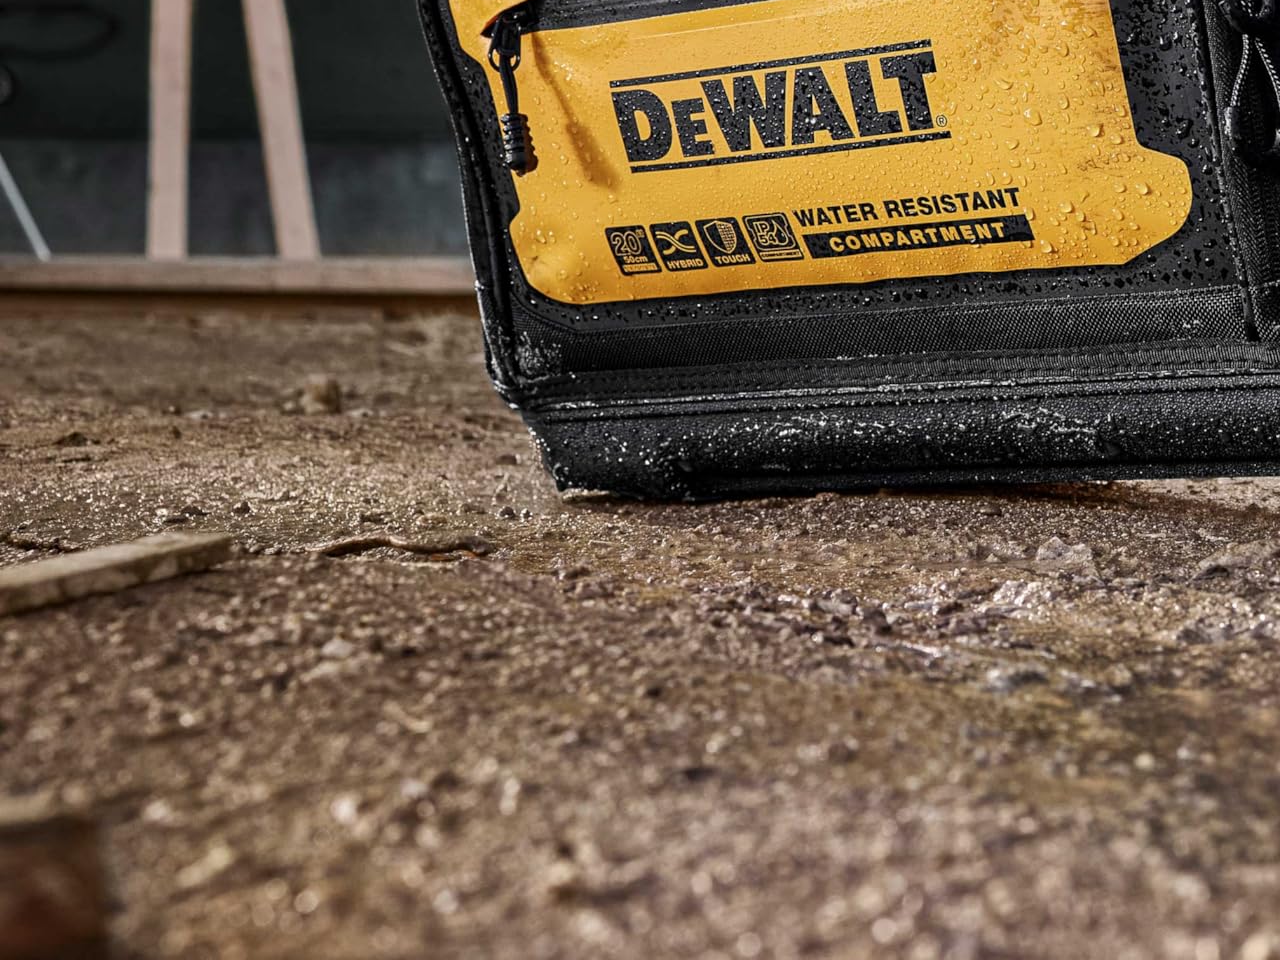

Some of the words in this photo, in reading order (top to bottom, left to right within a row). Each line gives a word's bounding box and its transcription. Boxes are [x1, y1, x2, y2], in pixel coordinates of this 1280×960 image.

[611, 51, 937, 162] DEWALT
[793, 202, 879, 227] WATER
[883, 187, 1020, 218] RESISTANT
[753, 221, 770, 234] IP
[829, 222, 1005, 252] COMPARTMENT
[666, 258, 704, 270] HYBRID
[714, 253, 751, 265] TOUGH
